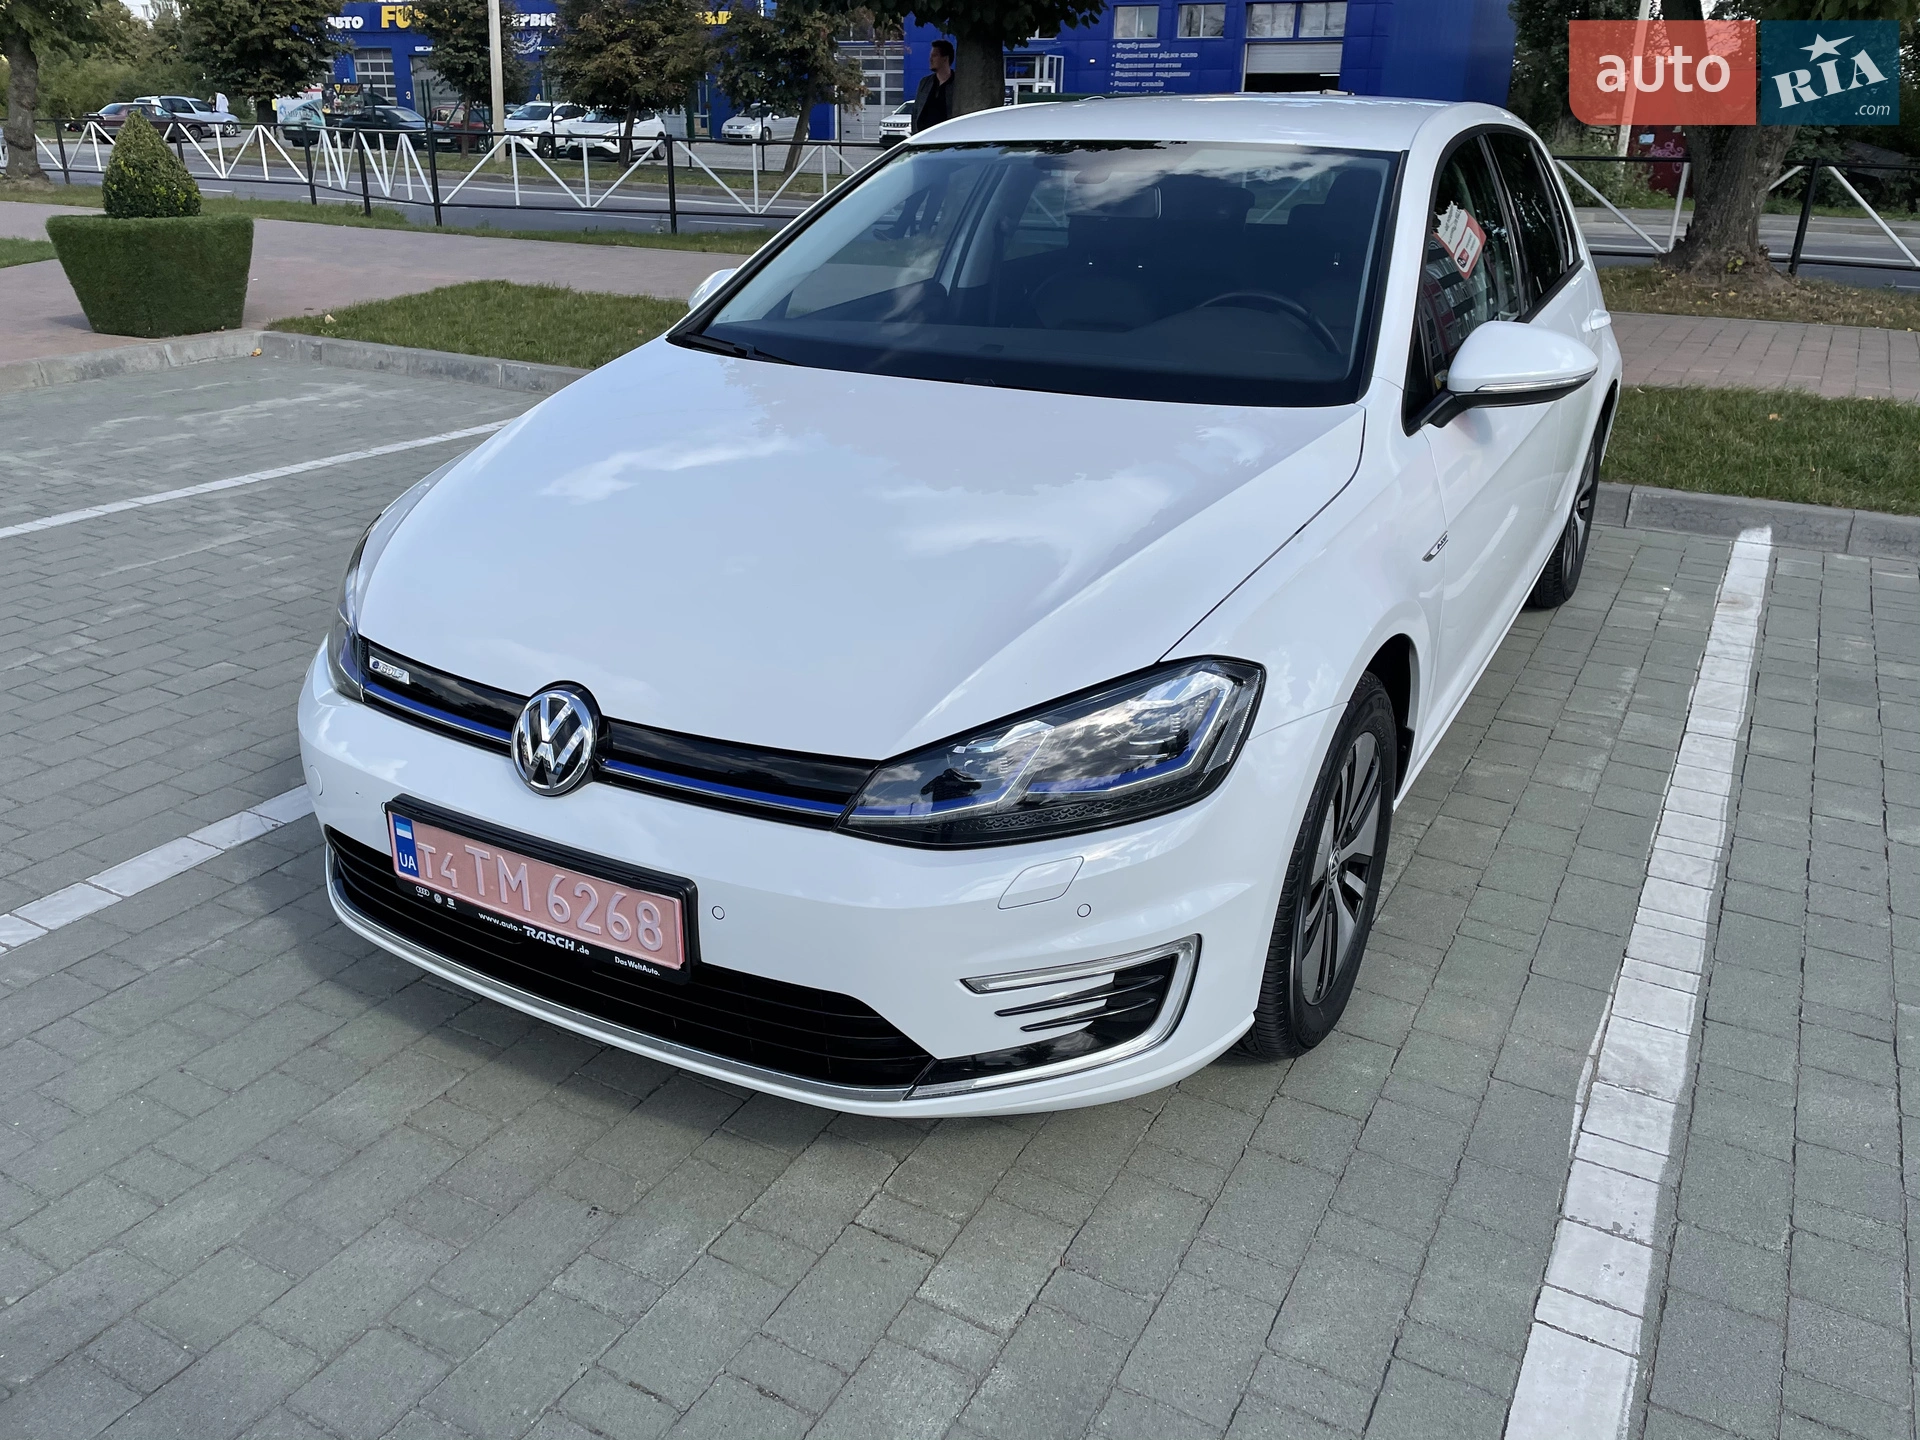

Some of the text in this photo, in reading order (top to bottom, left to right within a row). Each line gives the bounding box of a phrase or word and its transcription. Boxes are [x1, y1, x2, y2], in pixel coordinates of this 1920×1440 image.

[398, 851, 417, 871] UA
[417, 842, 664, 952] T4 TM 6268
